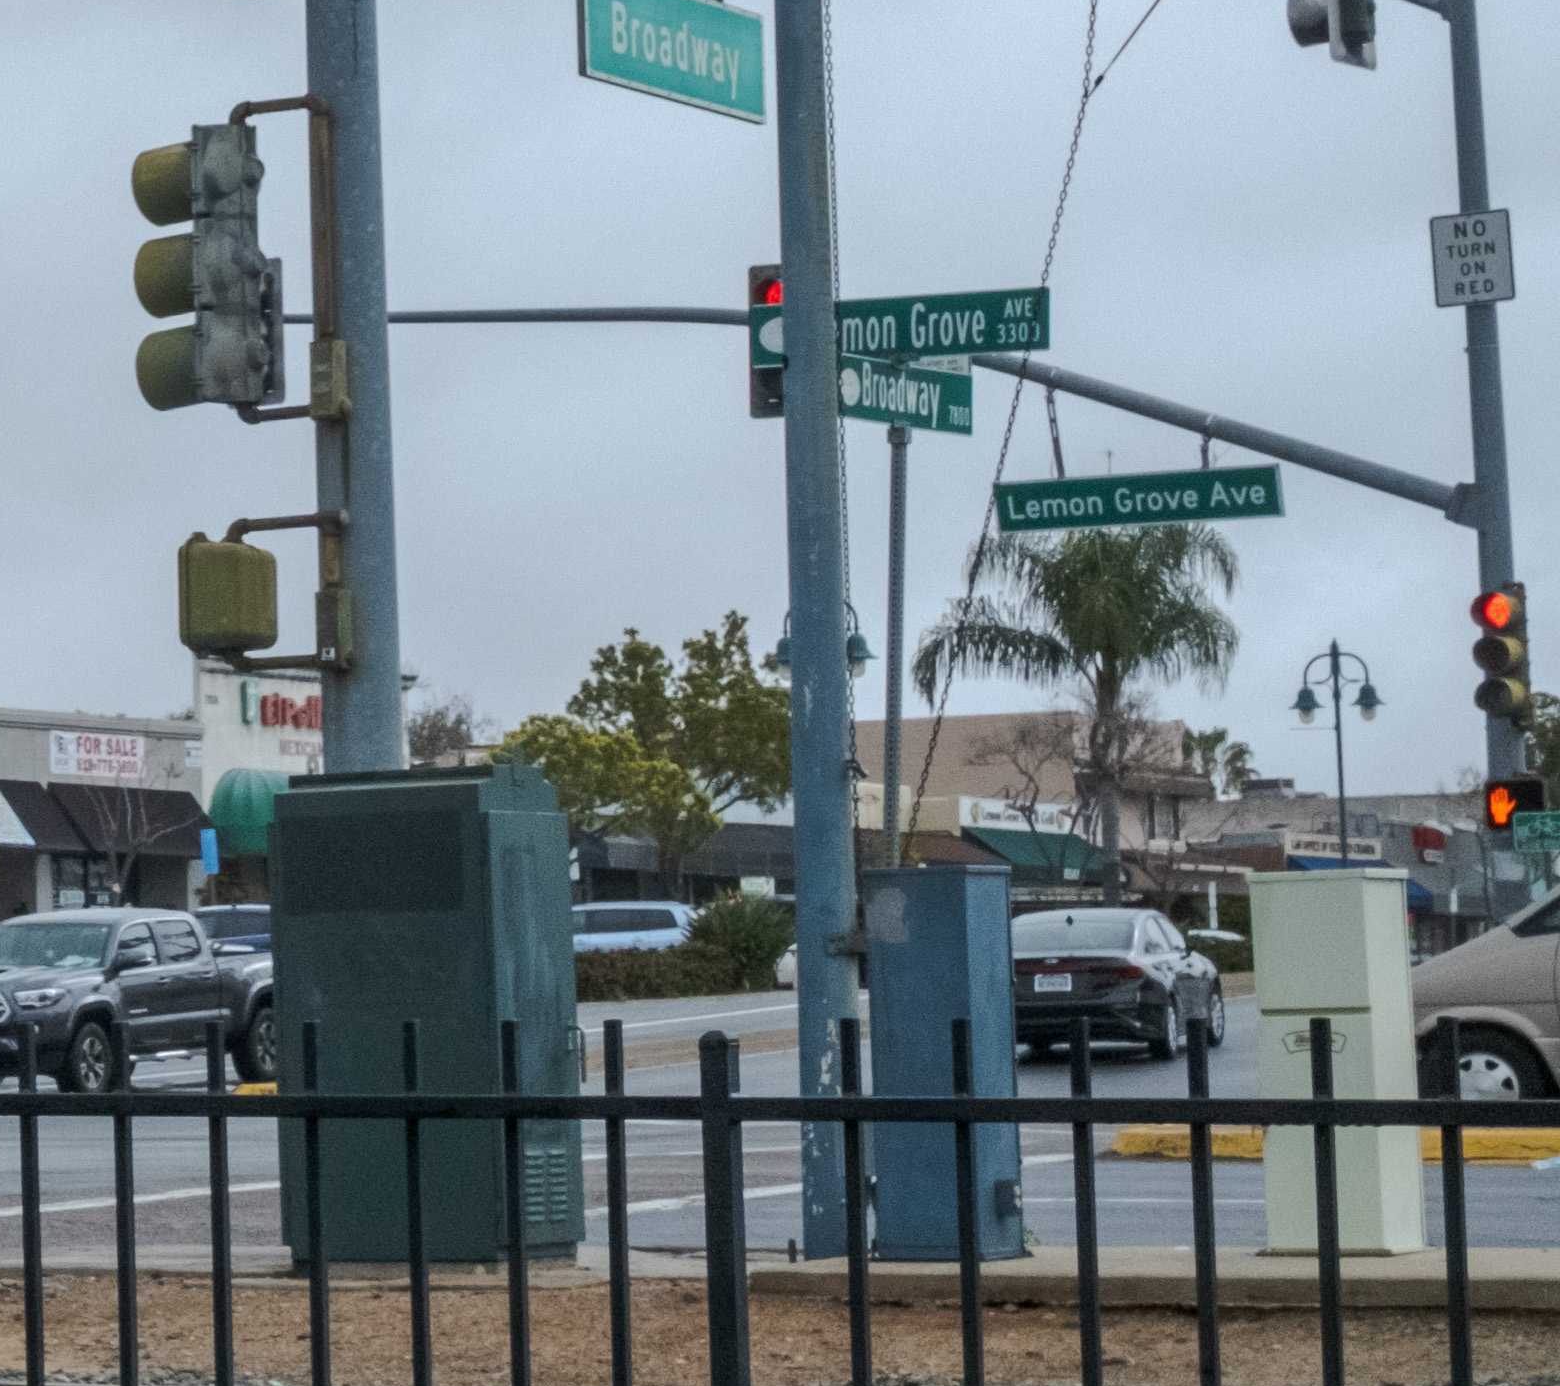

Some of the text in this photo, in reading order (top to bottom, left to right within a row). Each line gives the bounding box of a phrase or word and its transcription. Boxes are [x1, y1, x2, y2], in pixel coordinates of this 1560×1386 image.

[611, 0, 740, 101] Broadway
[1453, 219, 1486, 239] NO
[1447, 240, 1496, 259] TURN
[1460, 261, 1486, 276] ON
[1455, 279, 1494, 296] RED
[842, 297, 1033, 351] mon Grove AVE
[862, 361, 940, 428] Broadway
[1007, 480, 1266, 520] Lemon Grove Ave
[76, 734, 102, 755] FOR
[106, 737, 138, 757] SALE
